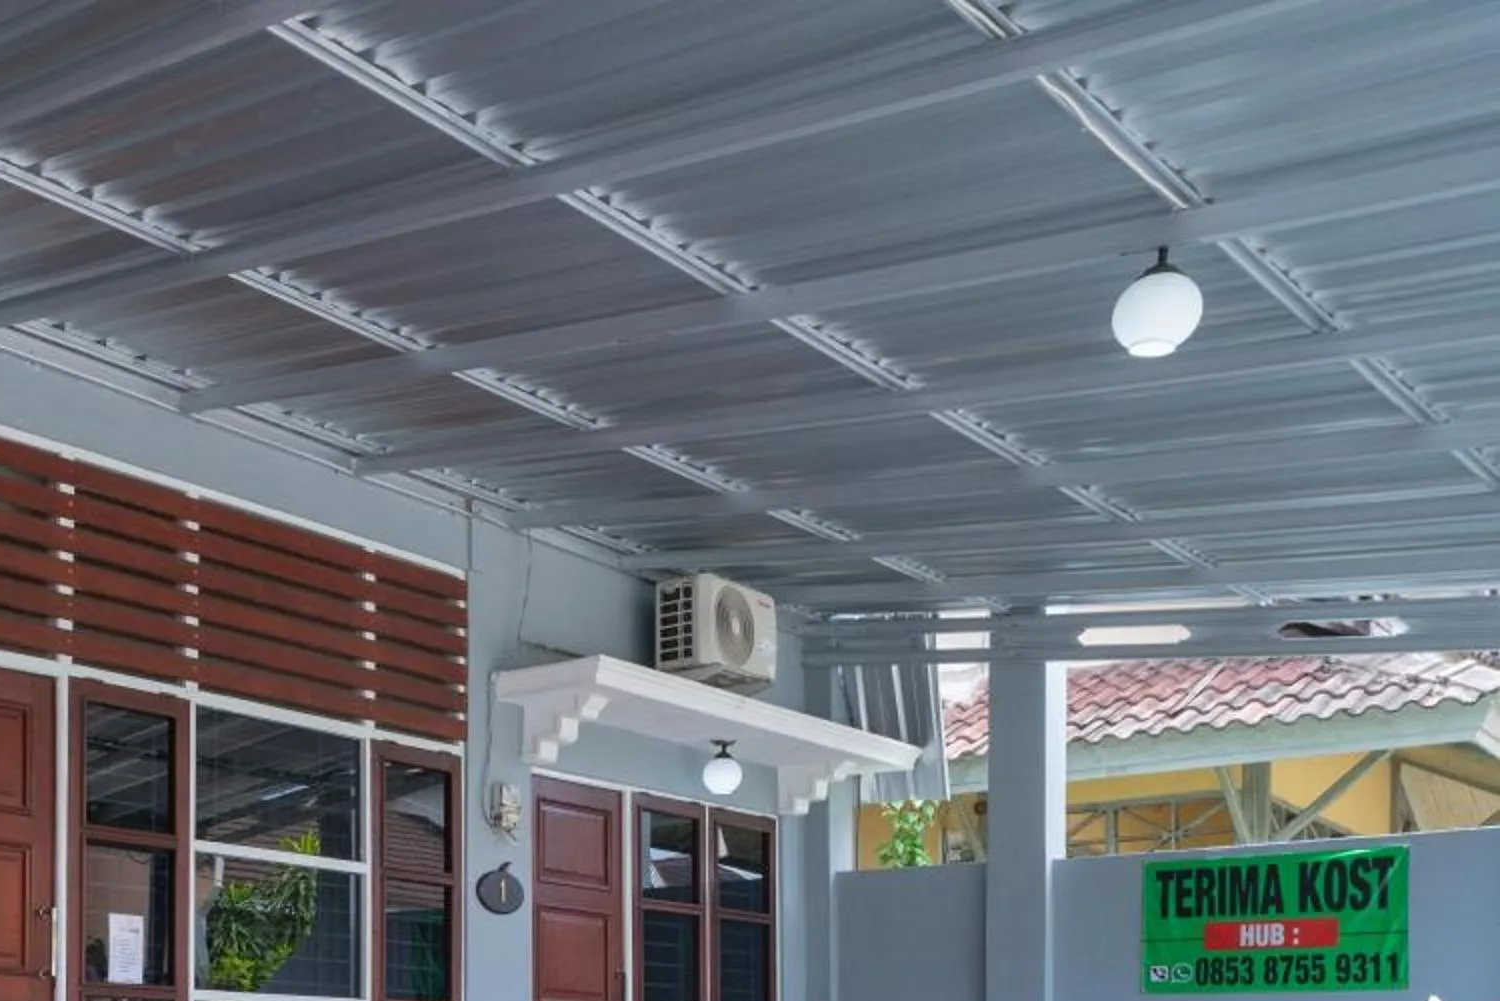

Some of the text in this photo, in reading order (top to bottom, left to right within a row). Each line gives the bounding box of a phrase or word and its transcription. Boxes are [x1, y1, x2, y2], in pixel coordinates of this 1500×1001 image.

[1155, 857, 1396, 919] TERIMA KOST
[1239, 923, 1285, 948] HUB
[1195, 951, 1399, 986] 0853 8755 9311
